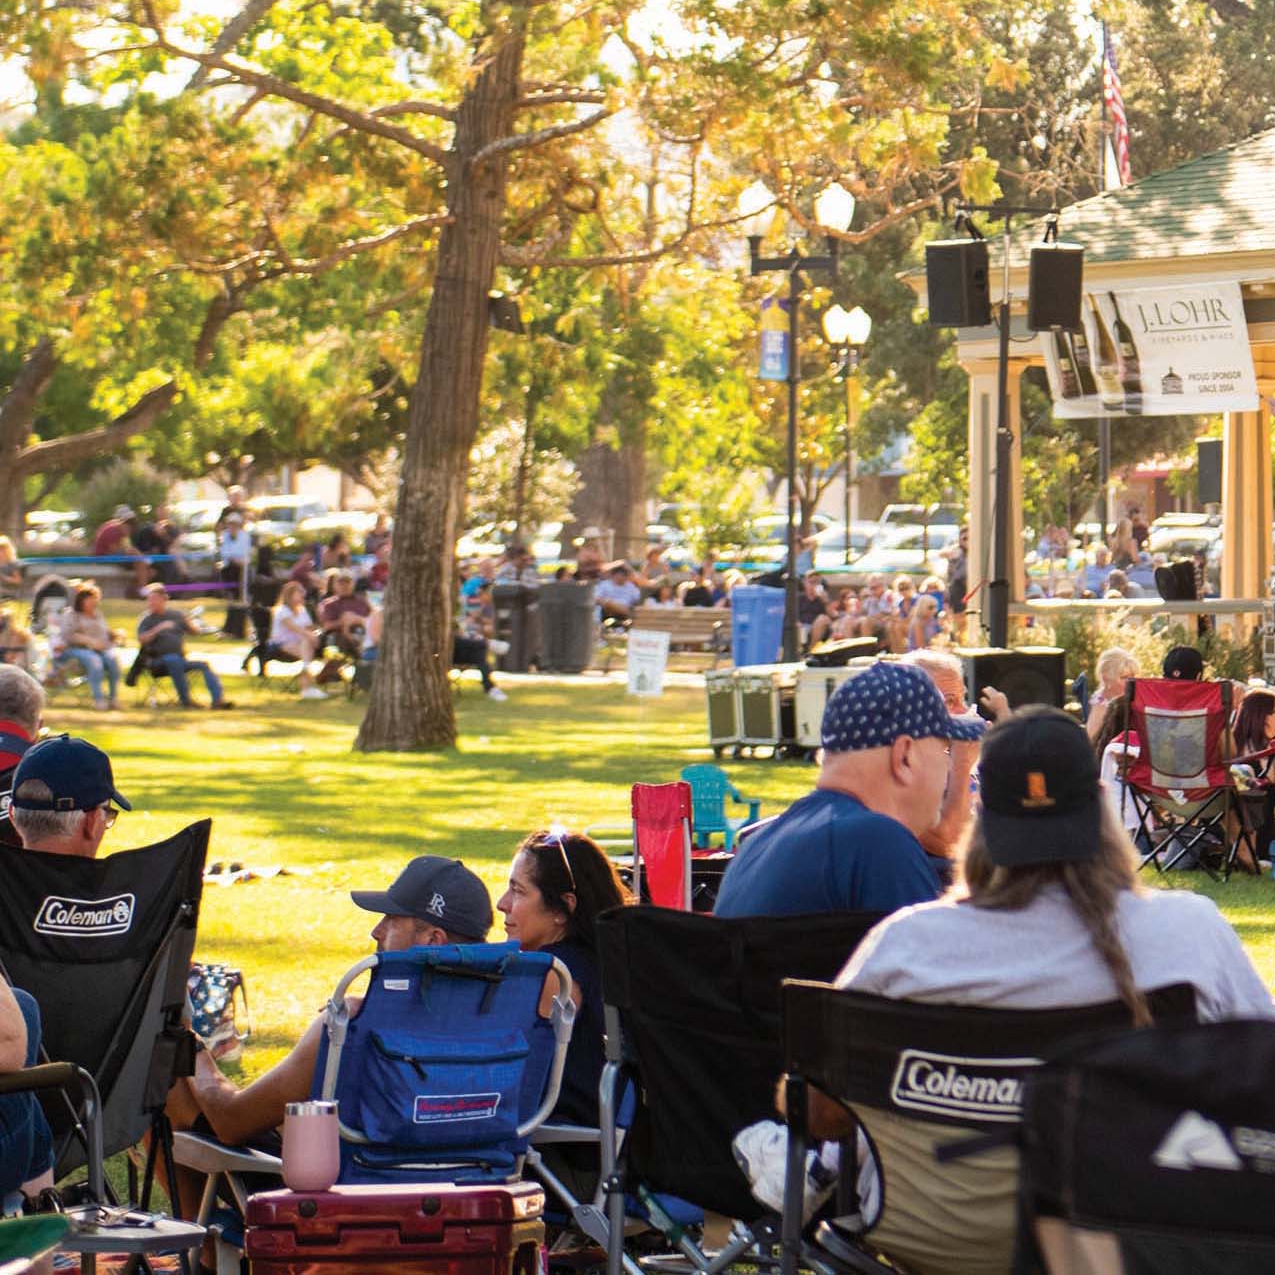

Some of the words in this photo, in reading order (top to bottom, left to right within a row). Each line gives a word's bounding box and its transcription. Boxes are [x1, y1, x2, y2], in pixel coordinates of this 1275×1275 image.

[1138, 298, 1231, 333] J.LOHR
[1212, 371, 1241, 381] SPONSOR
[45, 901, 113, 925] Coleman
